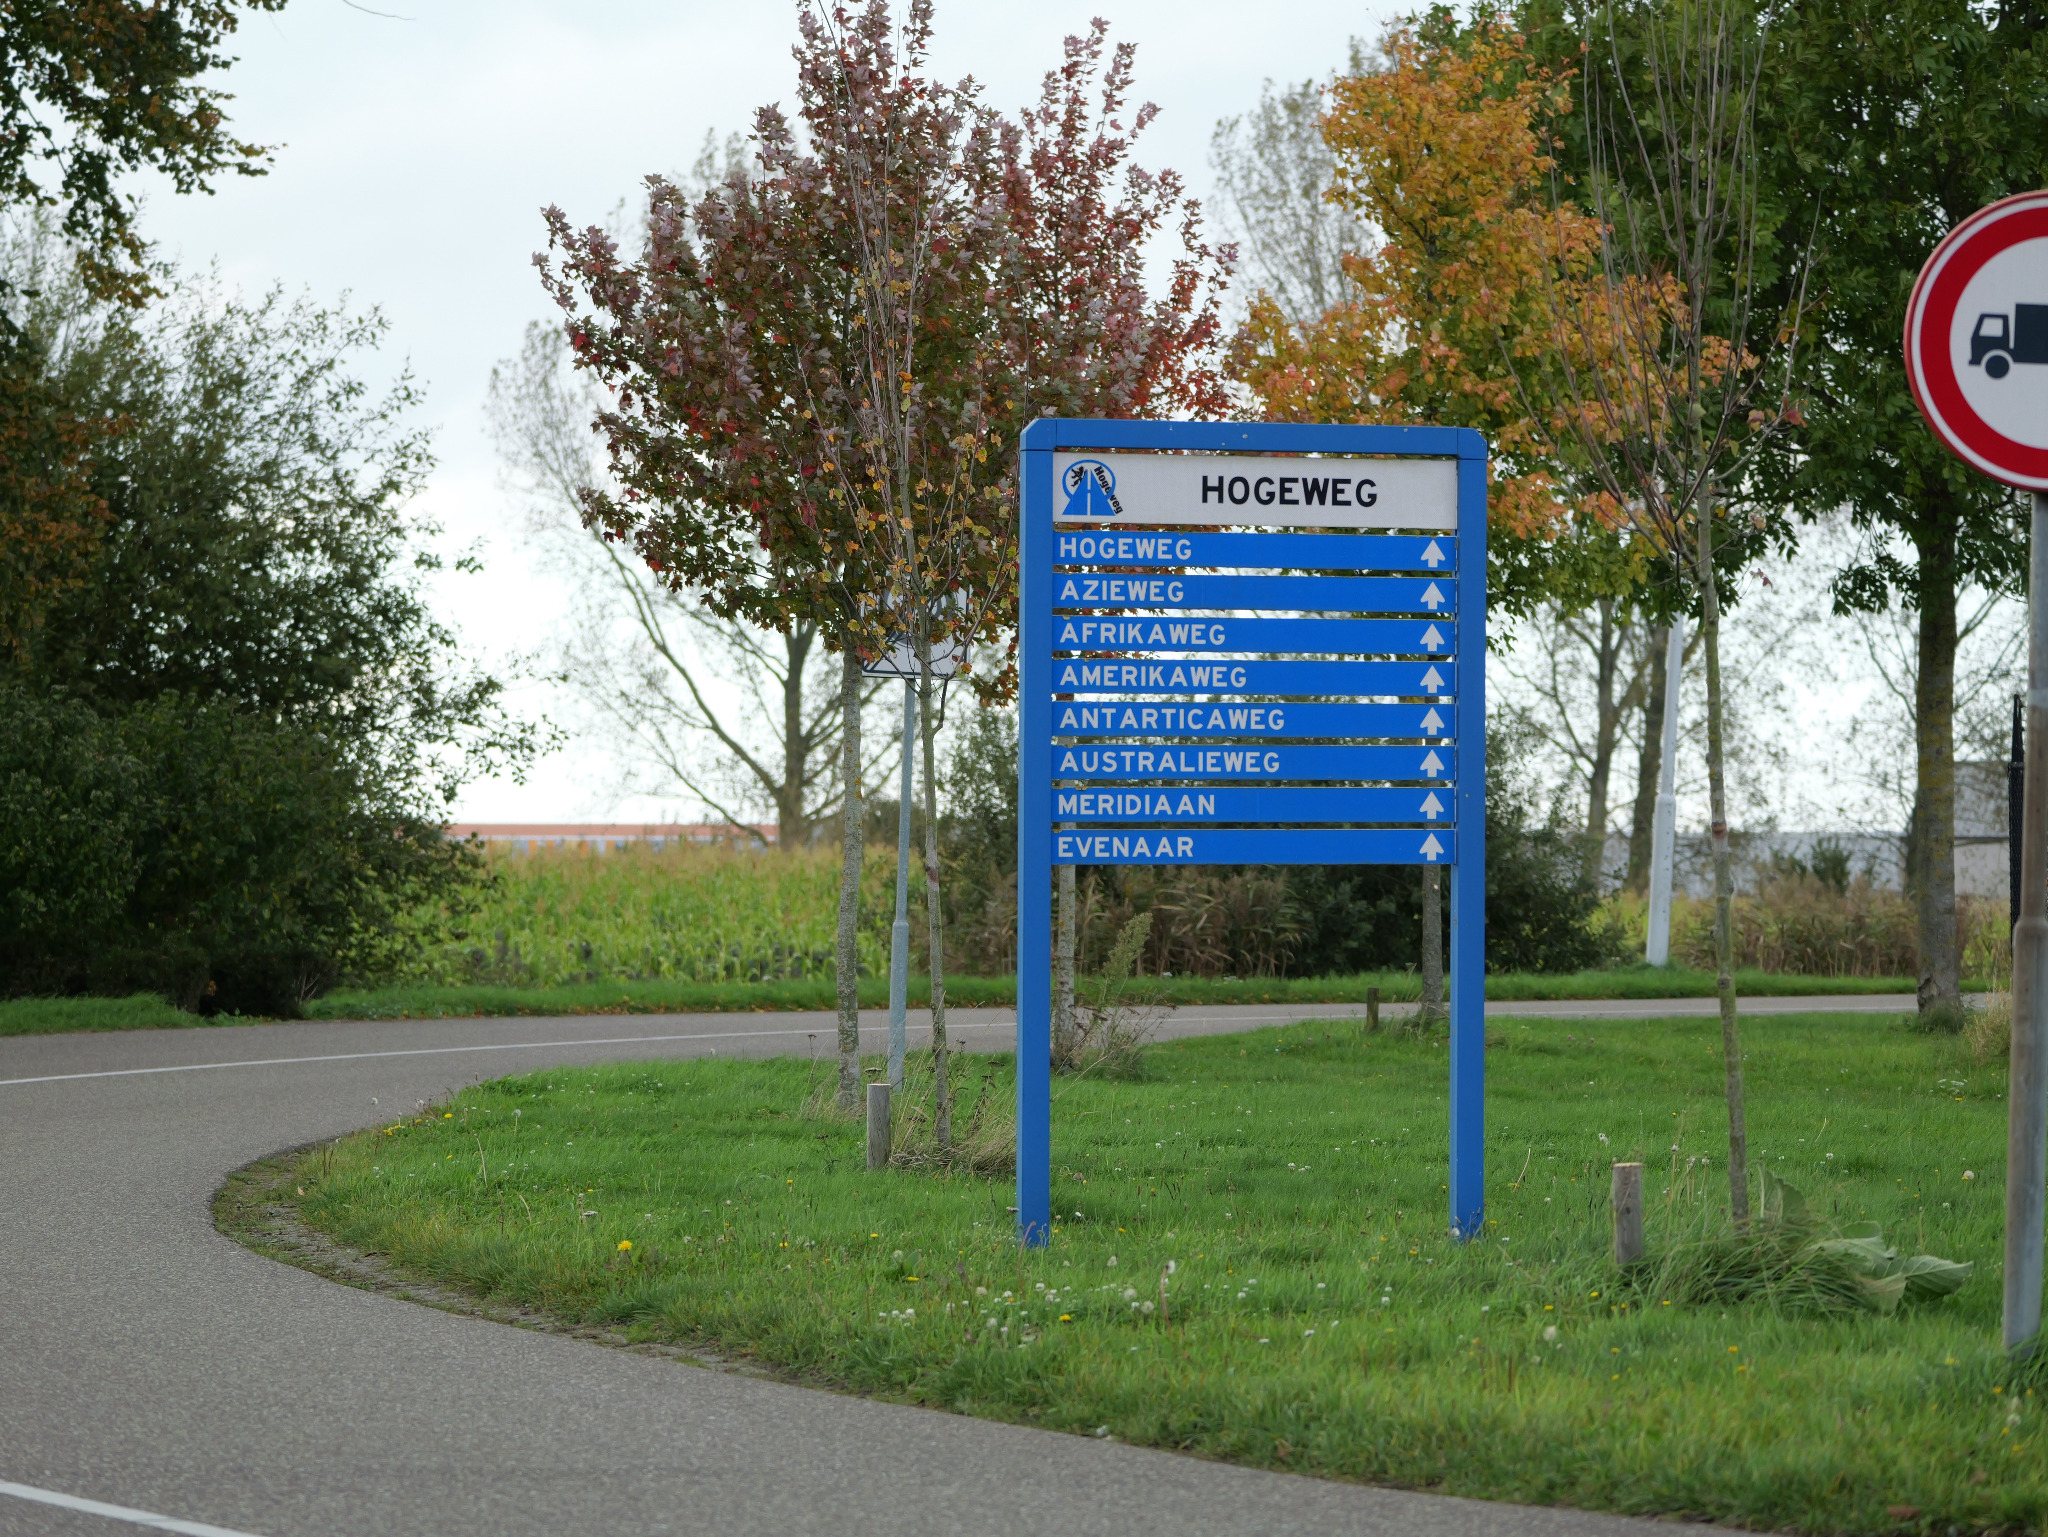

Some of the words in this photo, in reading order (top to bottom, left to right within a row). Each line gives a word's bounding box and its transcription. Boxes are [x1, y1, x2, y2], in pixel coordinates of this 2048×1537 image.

[1202, 476, 1377, 507] HOGEWEG
[1061, 538, 1191, 559] HOGEWEG
[1061, 580, 1183, 602] AZIEWEG
[1061, 623, 1225, 645] AFRIKAWEG
[1061, 666, 1246, 687] AMERIKAWEG
[1061, 708, 1284, 730] ANTARTICAWEG
[1060, 752, 1279, 772] AUSTRALIEWEG
[1059, 795, 1214, 814] MERIDIAAN
[1059, 837, 1193, 857] EVENAAR
